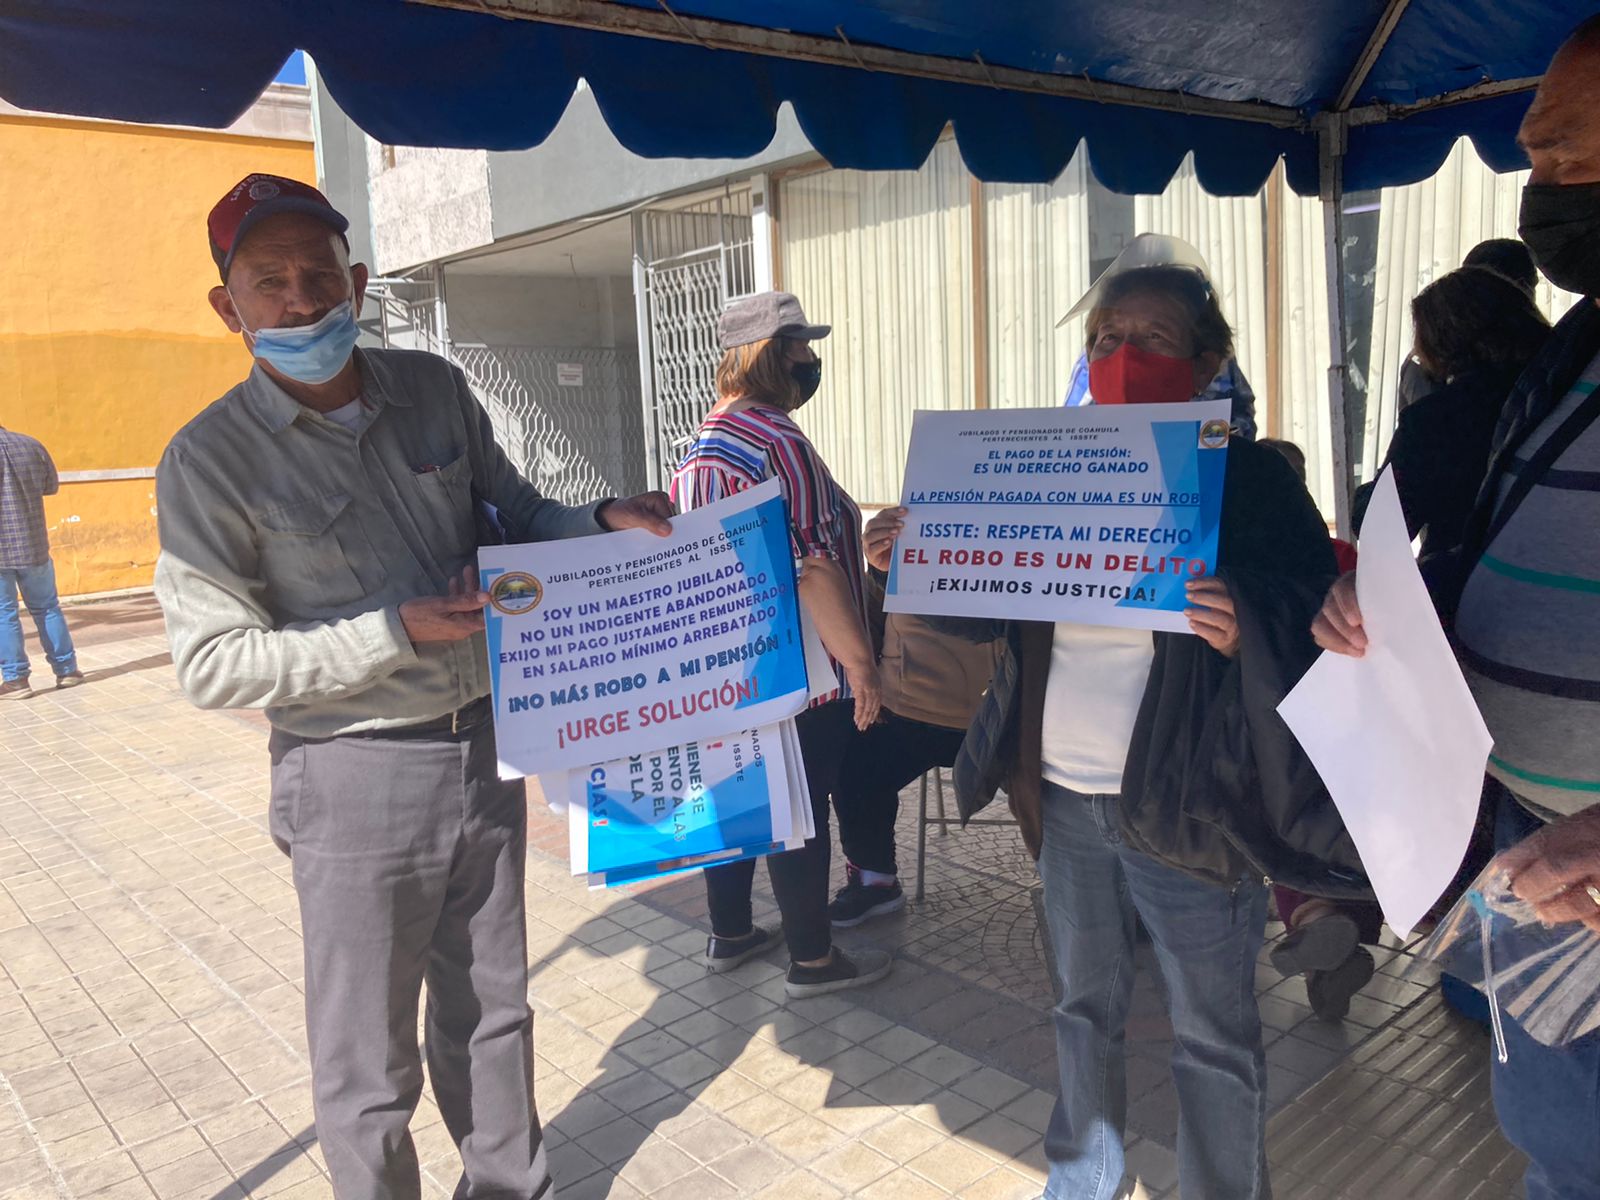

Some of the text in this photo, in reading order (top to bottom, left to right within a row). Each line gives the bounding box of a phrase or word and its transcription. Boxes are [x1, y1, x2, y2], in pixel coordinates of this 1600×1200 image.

[988, 446, 1131, 460] EL PAGO DE LA PENSIÓN:
[1008, 428, 1063, 436] PENSIONADOS
[973, 462, 1149, 474] ES UN DERECHO GANADO
[910, 488, 1207, 504] LA PENSIÓN PAGADA CON UMA ES UN ROB
[547, 516, 768, 584] JUBILADOS Y PENSIONADOS DE COAHUILA
[920, 523, 1193, 545] ISSSTE: RESPETA MI DERECHO
[589, 537, 745, 589] PERTENECIENTES AL ISSSTE
[903, 549, 1208, 577] EL ROBO ES UN DELITO
[521, 572, 767, 644] NO UN INDIGENTE ABANDONADO
[543, 561, 745, 622] SOY UN MAESTRO JUBILADO
[930, 578, 1156, 602] ¡EXIJIMOS JUSTICIA!
[499, 583, 786, 664] EXIJO MI PAGO JUSTAMENTE REMUNERADO
[522, 605, 776, 679] EN SALARIO MÍNIMO ARREBATADO
[551, 683, 589, 706] MÁS
[594, 672, 647, 698] ROBO
[657, 666, 671, 684] A
[680, 658, 700, 678] MI
[705, 634, 779, 671] PENSIÓN
[558, 676, 759, 749] ¡URGE SOLUCIÓN!
[733, 743, 745, 783] ISSSTE
[631, 778, 645, 804] LA
[650, 756, 666, 817] POR EL
[668, 745, 686, 842] ENTO A LAS
[692, 796, 705, 815] SE
